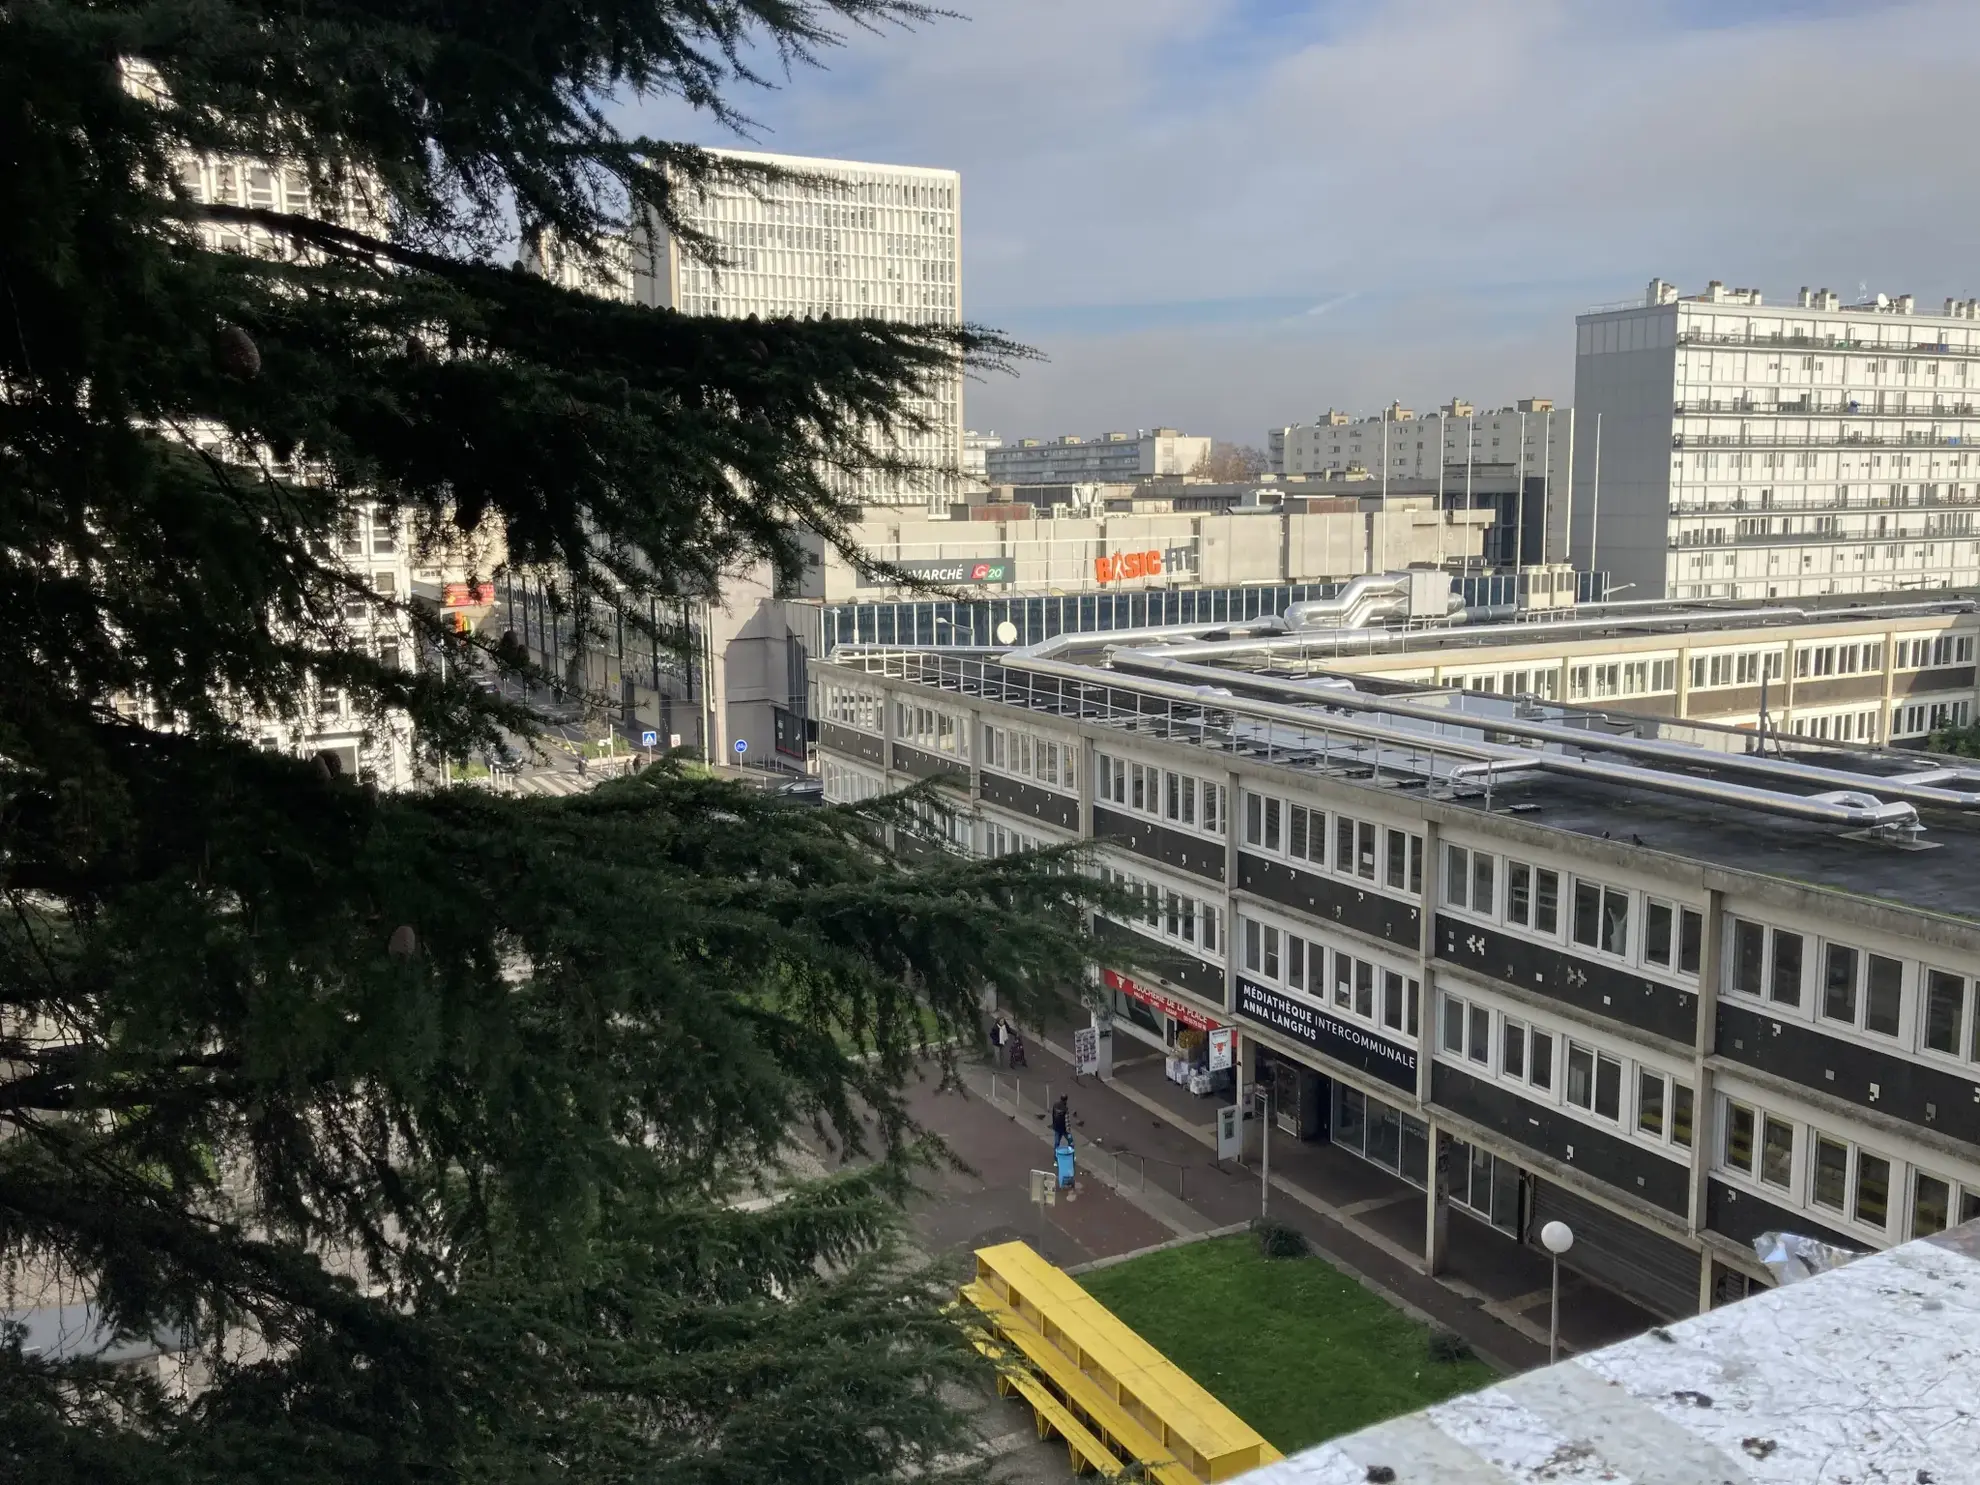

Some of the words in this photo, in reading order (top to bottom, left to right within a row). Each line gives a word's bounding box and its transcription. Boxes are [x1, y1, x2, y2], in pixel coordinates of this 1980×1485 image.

[870, 564, 963, 583] SUMARCHÉ
[973, 565, 1003, 580] G20
[1132, 982, 1166, 1004] BOUCHERIE
[1166, 999, 1177, 1009] DE
[1177, 1004, 1186, 1014] LA
[1186, 1008, 1208, 1023] PLACE
[1243, 999, 1269, 1019] ANNA
[1271, 1011, 1317, 1041] LANGFUS
[1243, 984, 1312, 1024] MÉDIATHÈQUE
[1315, 1015, 1416, 1069] INTERCOMMUNALE
